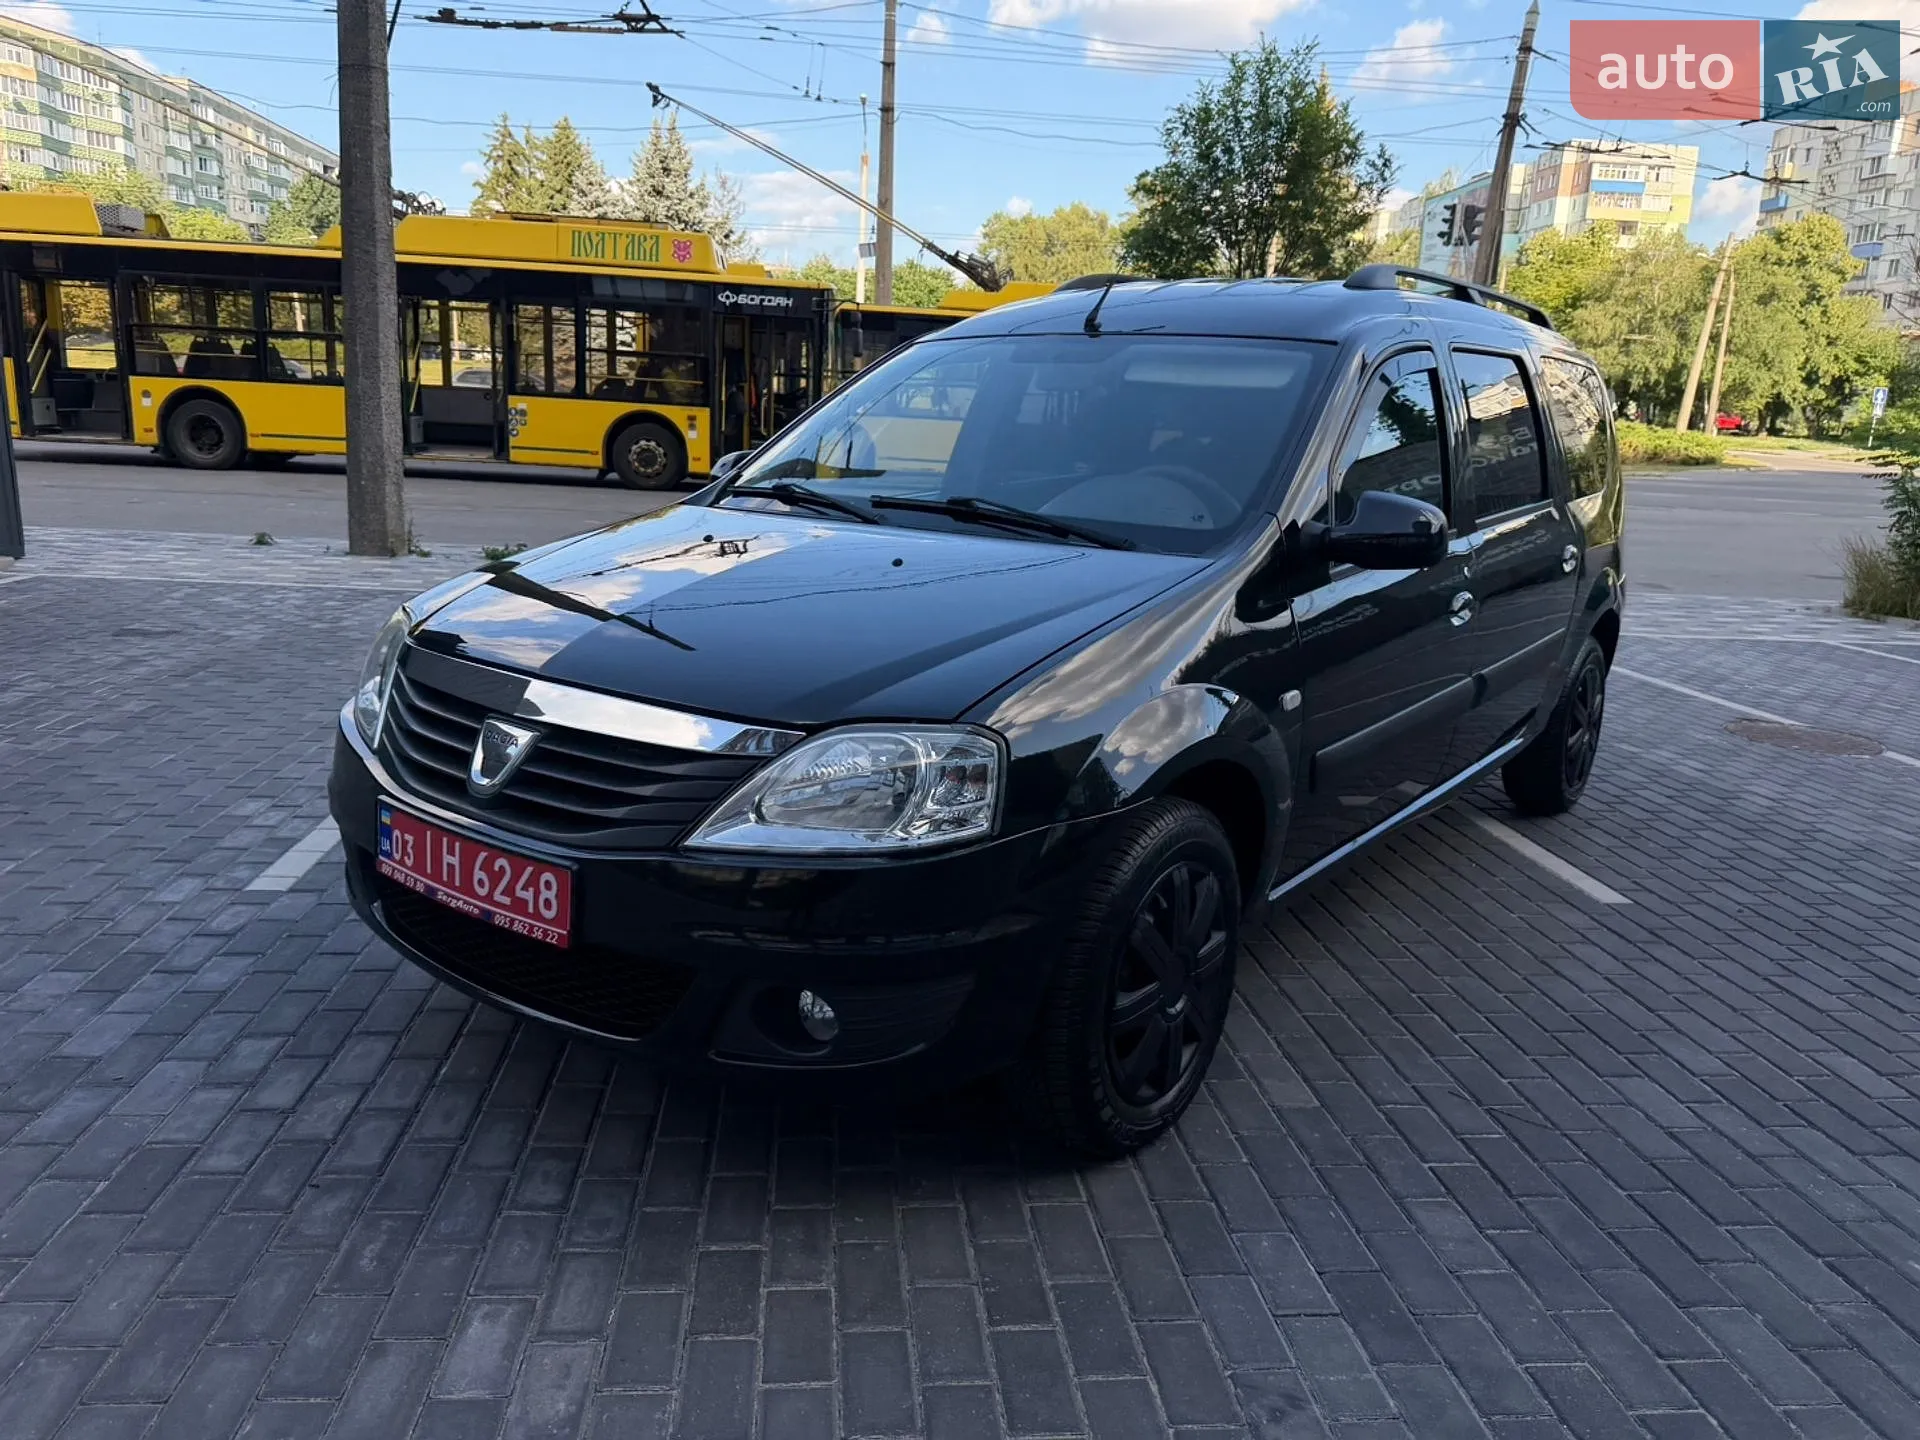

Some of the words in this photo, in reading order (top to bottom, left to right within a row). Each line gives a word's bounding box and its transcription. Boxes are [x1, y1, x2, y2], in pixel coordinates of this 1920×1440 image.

[571, 229, 661, 262] ПОЛТАВА
[737, 293, 794, 308] БОГДАН
[381, 836, 391, 853] UA
[392, 829, 414, 867] 03
[473, 851, 559, 919] 6248
[436, 891, 481, 914] SergAuto
